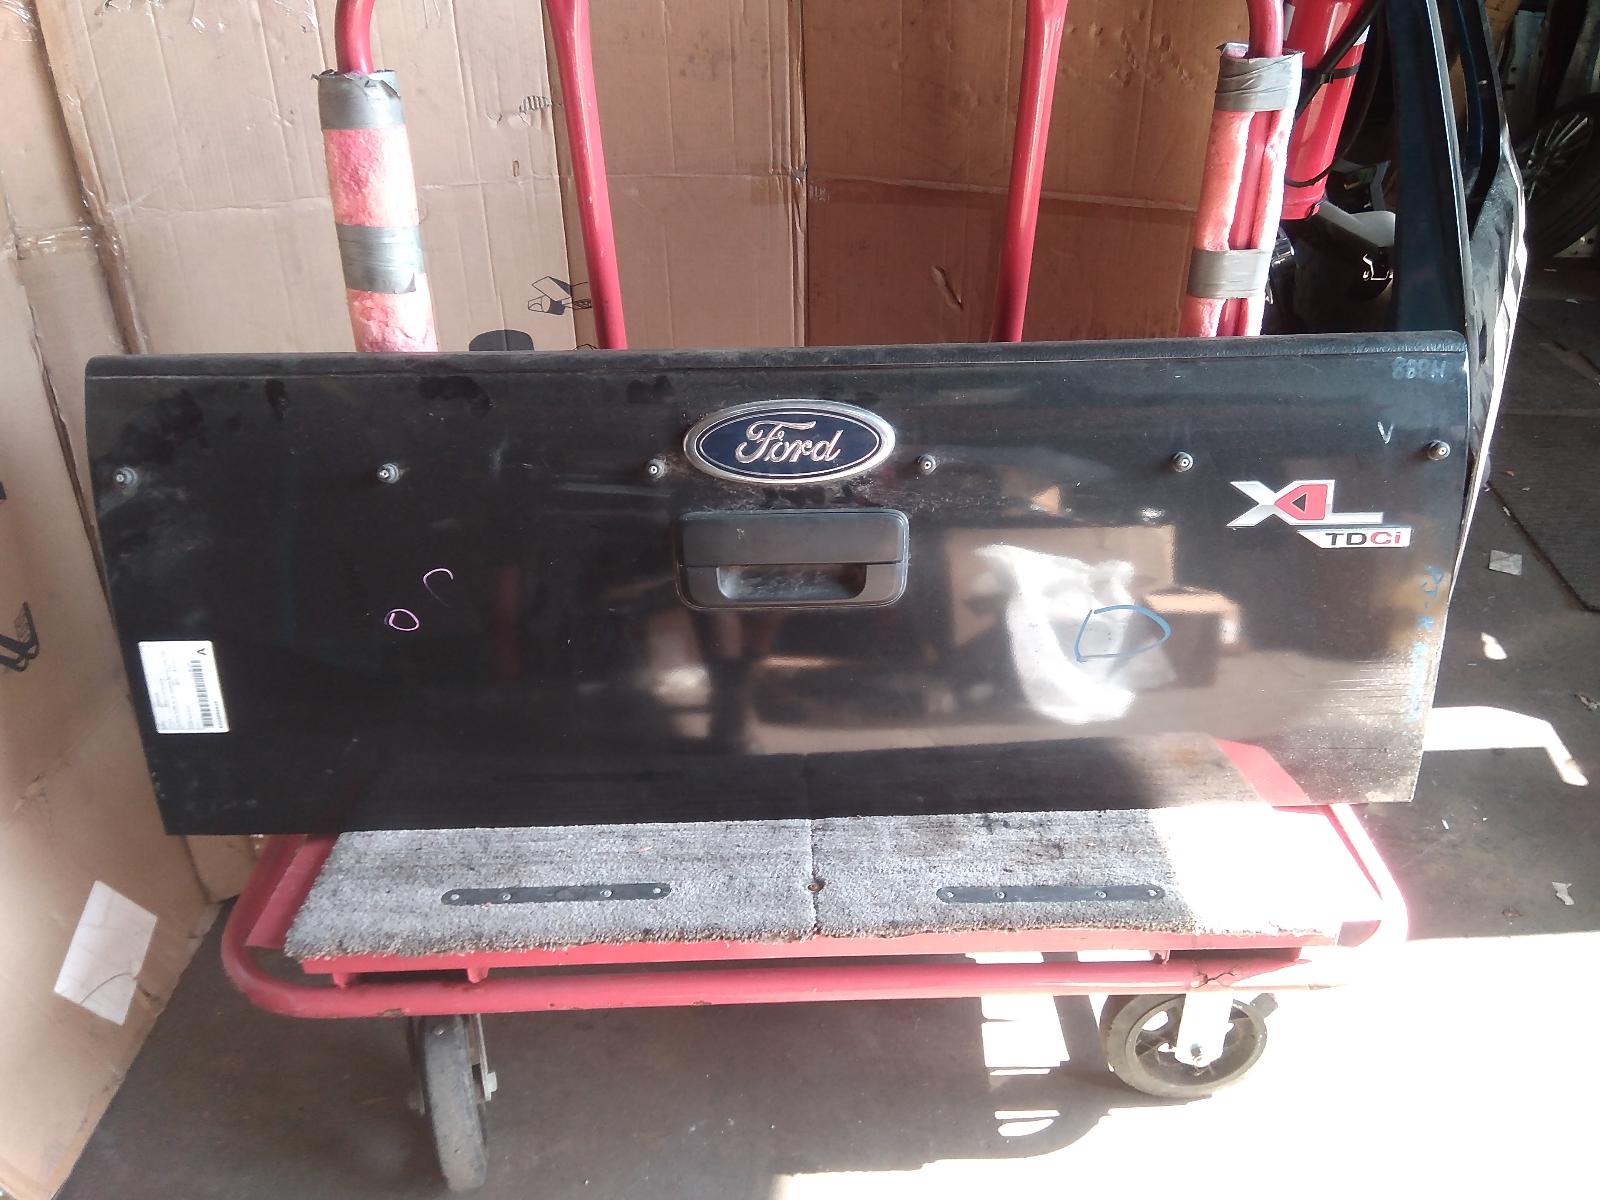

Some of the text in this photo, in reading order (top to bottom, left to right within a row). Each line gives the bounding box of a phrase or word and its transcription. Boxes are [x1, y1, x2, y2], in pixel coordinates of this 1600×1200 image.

[734, 420, 842, 464] Ford
[1226, 479, 1384, 527] XL
[1325, 531, 1402, 547] TDCi
